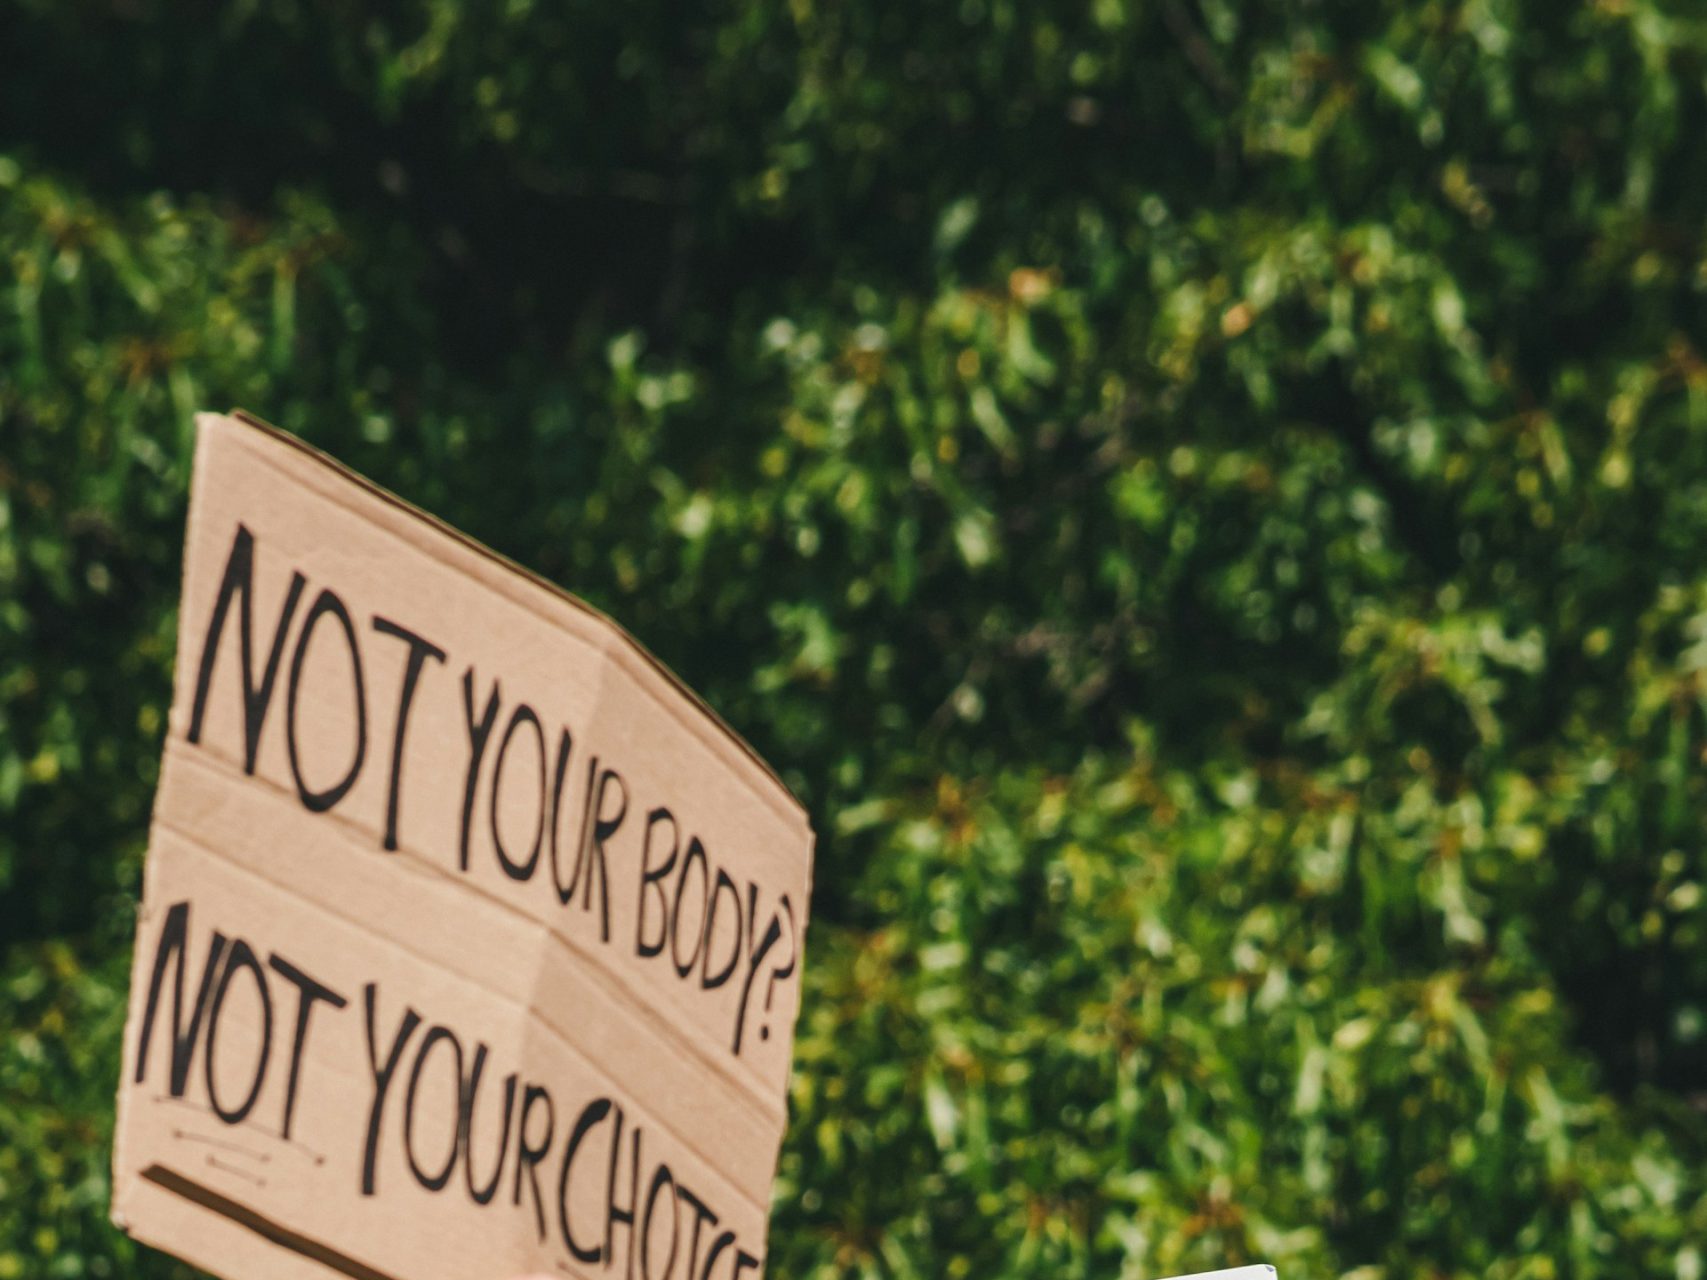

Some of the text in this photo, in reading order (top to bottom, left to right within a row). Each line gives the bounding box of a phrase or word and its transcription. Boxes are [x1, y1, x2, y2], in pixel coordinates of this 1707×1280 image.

[187, 523, 796, 1056] NOT YOUR BODY?
[135, 901, 347, 1140] NOT
[361, 982, 553, 1243] YOUR
